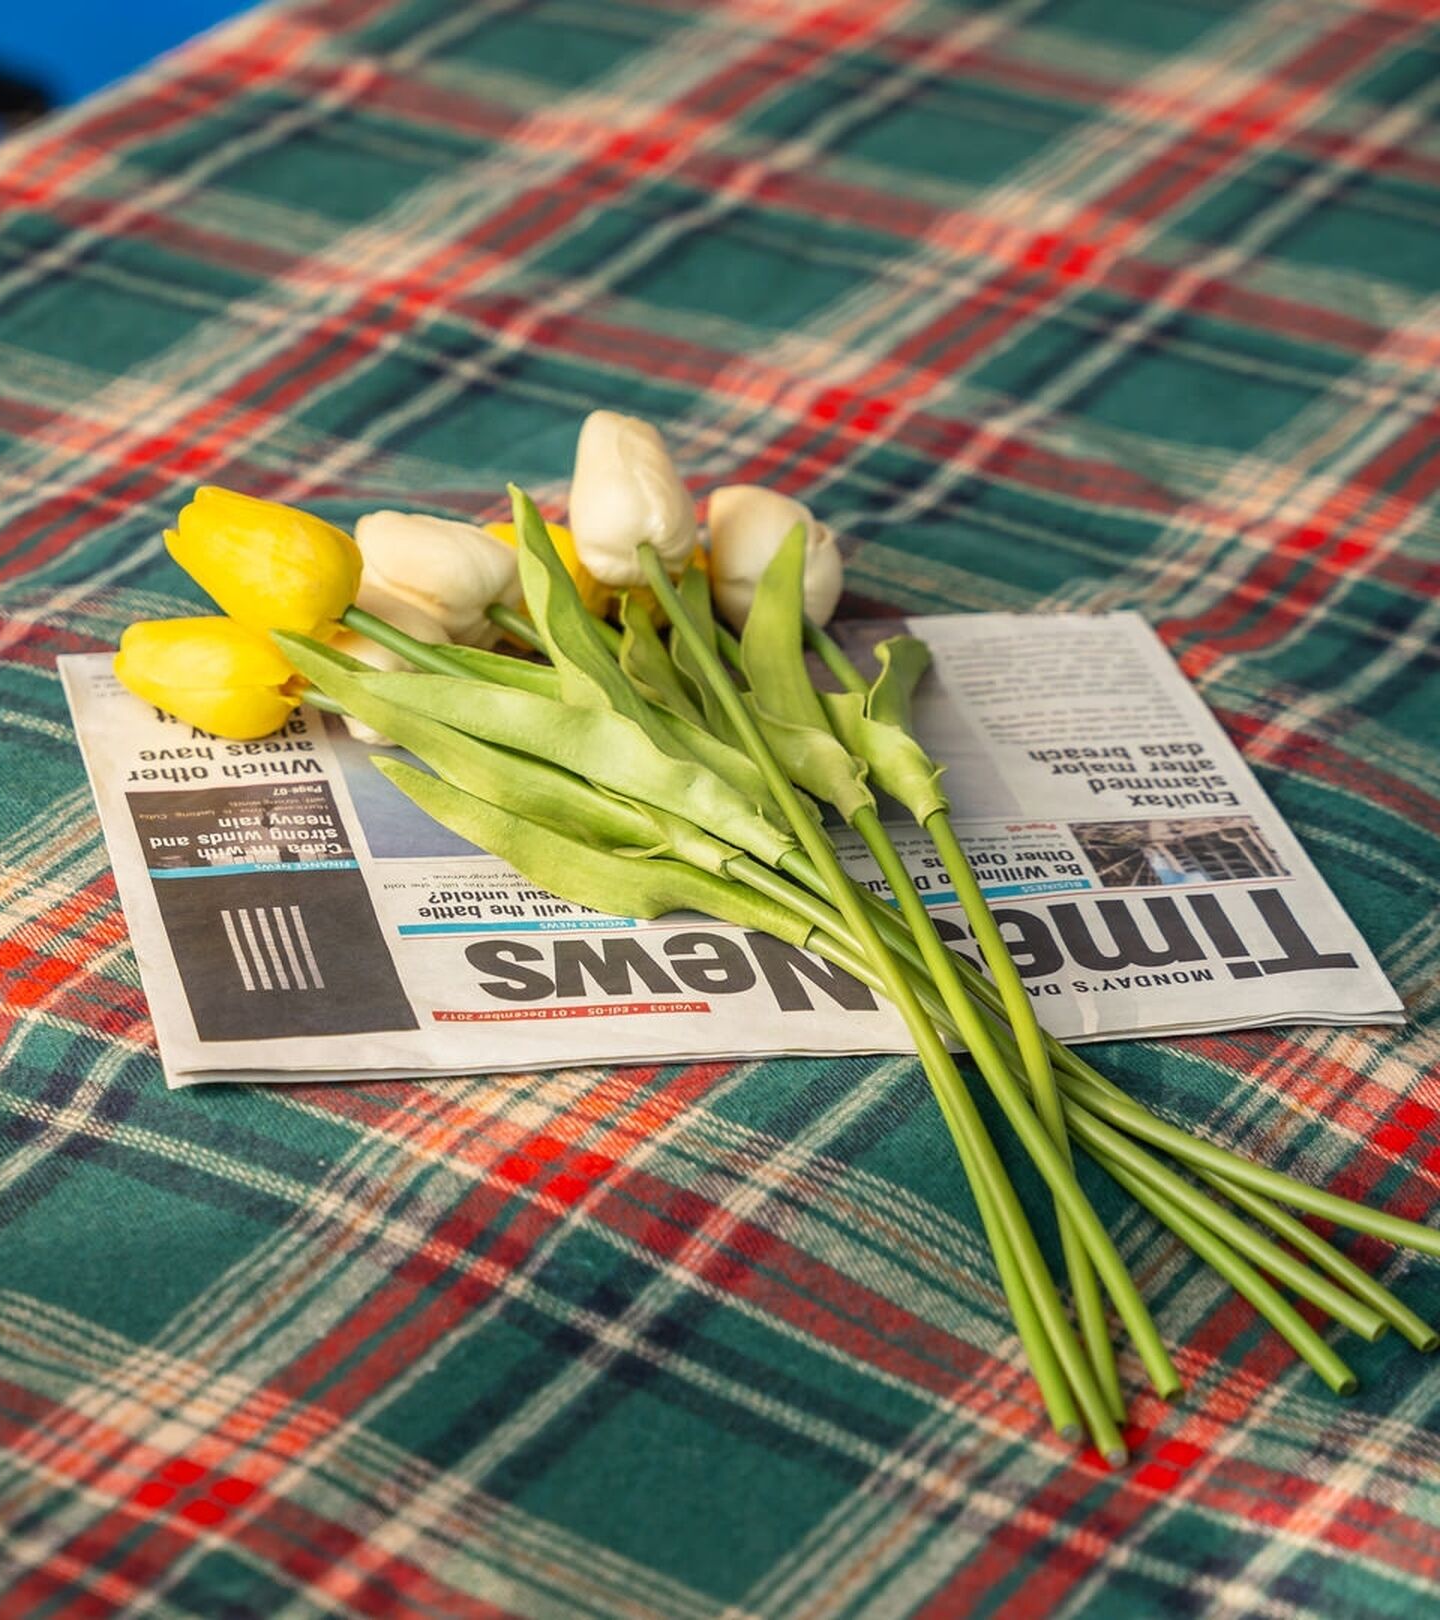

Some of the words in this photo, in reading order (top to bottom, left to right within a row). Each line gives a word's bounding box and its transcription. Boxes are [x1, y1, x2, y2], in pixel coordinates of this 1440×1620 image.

[138, 746, 214, 763] have
[224, 740, 314, 760] areas
[1028, 746, 1129, 764] breach
[1140, 742, 1204, 760] data
[222, 758, 324, 780] Which
[1050, 760, 1136, 777] major
[1149, 759, 1216, 774] after
[127, 766, 209, 784] other
[1088, 775, 1228, 794] slammed
[1126, 790, 1240, 809] Equifax
[218, 816, 262, 830] rain
[269, 812, 334, 828] heavy
[196, 830, 262, 846] winds
[270, 826, 338, 844] strong
[148, 836, 190, 850] and
[288, 842, 343, 855] Cuba
[196, 846, 246, 861] with
[922, 852, 1006, 870] Optns
[1014, 850, 1076, 870] Other
[253, 862, 290, 872] NEWS
[292, 860, 351, 870] FINANCE
[1054, 863, 1083, 876] Be
[1021, 880, 1083, 892] BUSINESS
[428, 890, 510, 904] unfold?
[418, 906, 481, 920] battle
[490, 904, 524, 918] the
[528, 904, 572, 918] will
[538, 921, 577, 930] NEWS
[580, 920, 628, 929] WORLD
[465, 932, 879, 1012] News
[1072, 969, 1214, 994] MONDAY'S
[476, 1010, 546, 1020] December
